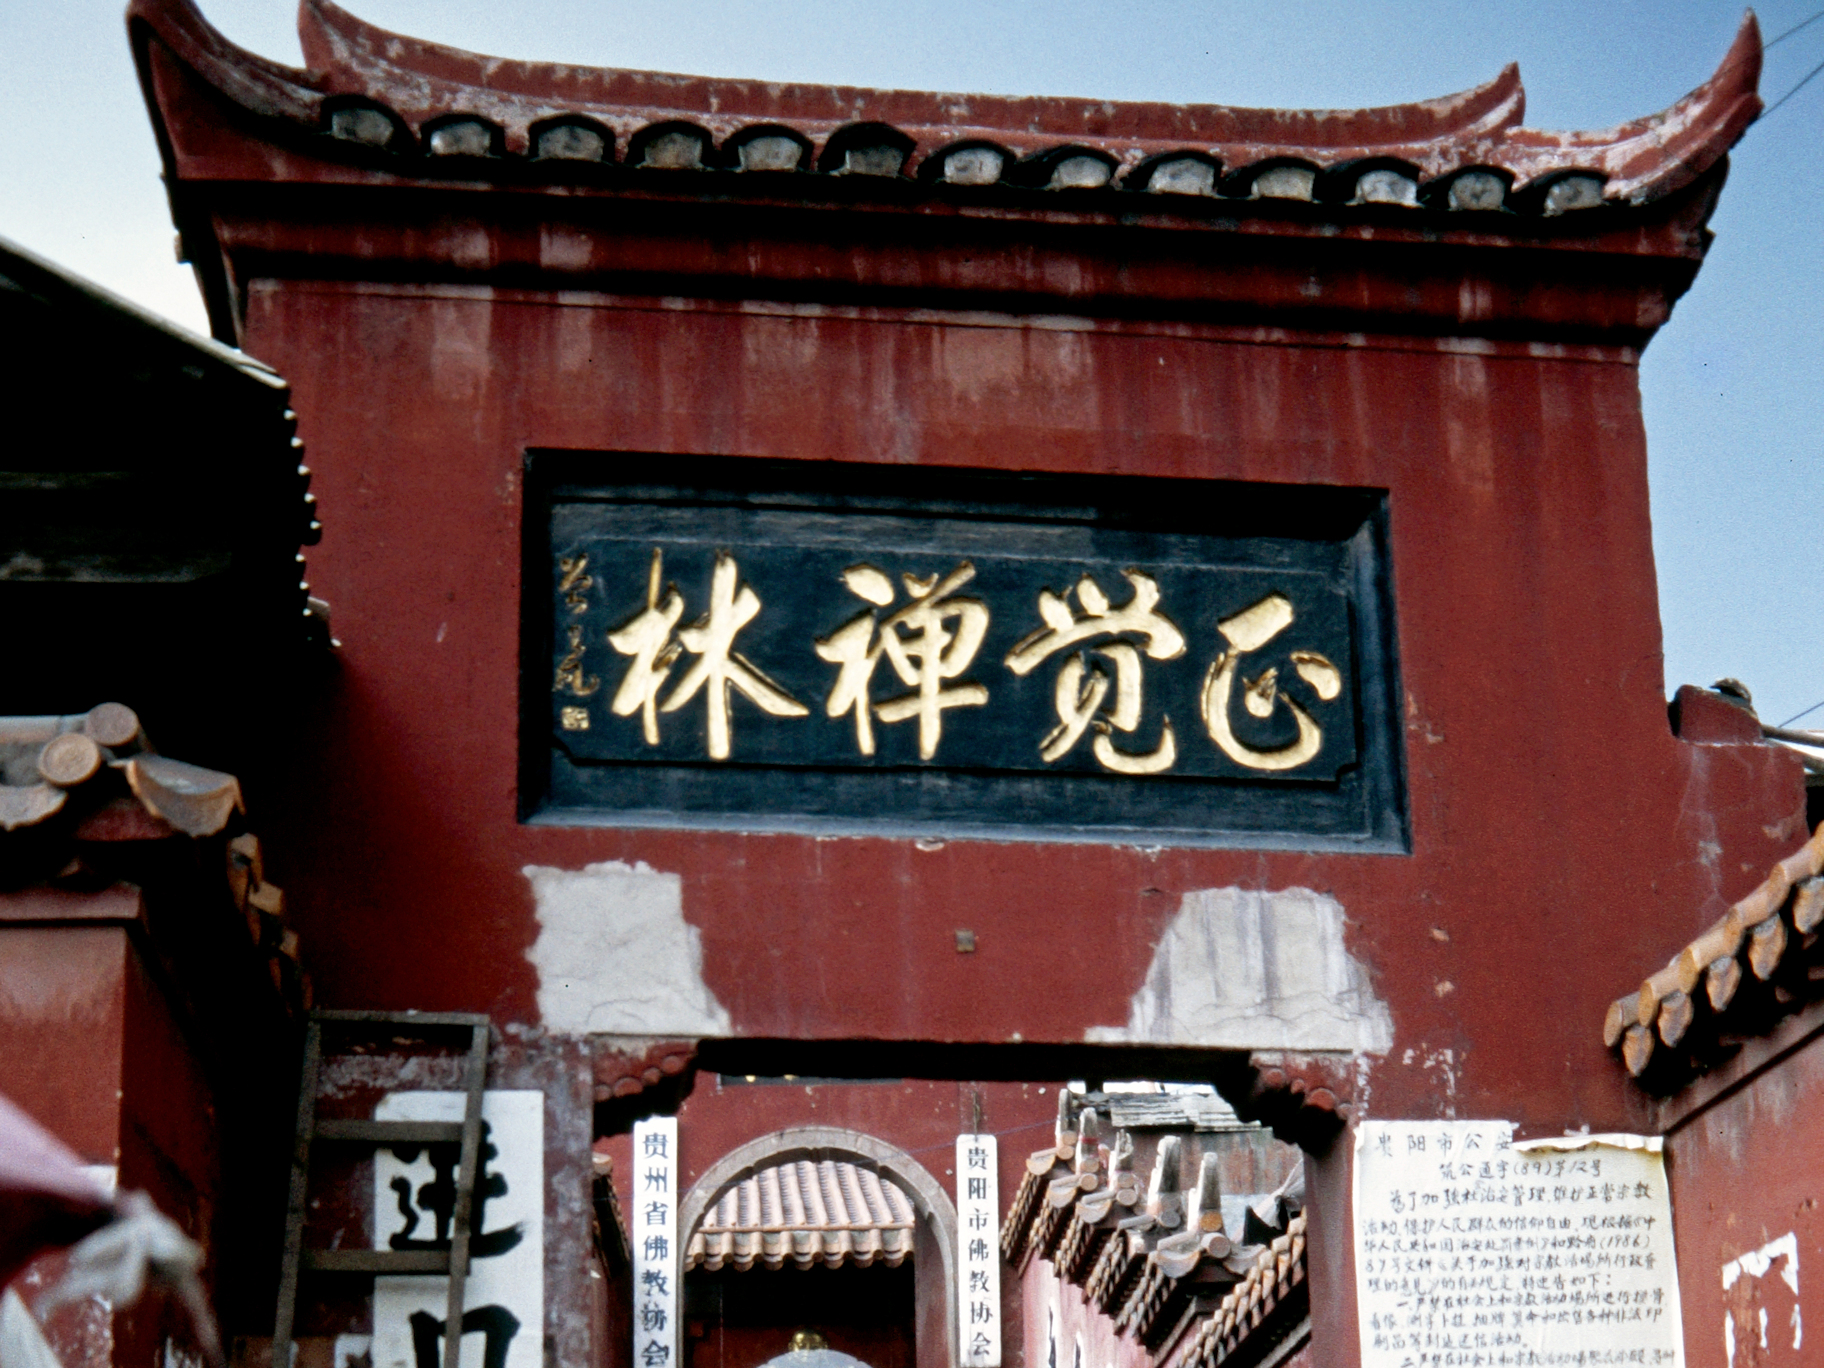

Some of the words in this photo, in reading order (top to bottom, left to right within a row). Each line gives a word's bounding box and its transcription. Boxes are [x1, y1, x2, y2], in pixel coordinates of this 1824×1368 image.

[966, 1146, 993, 1358] 贵阳市佛教协会
